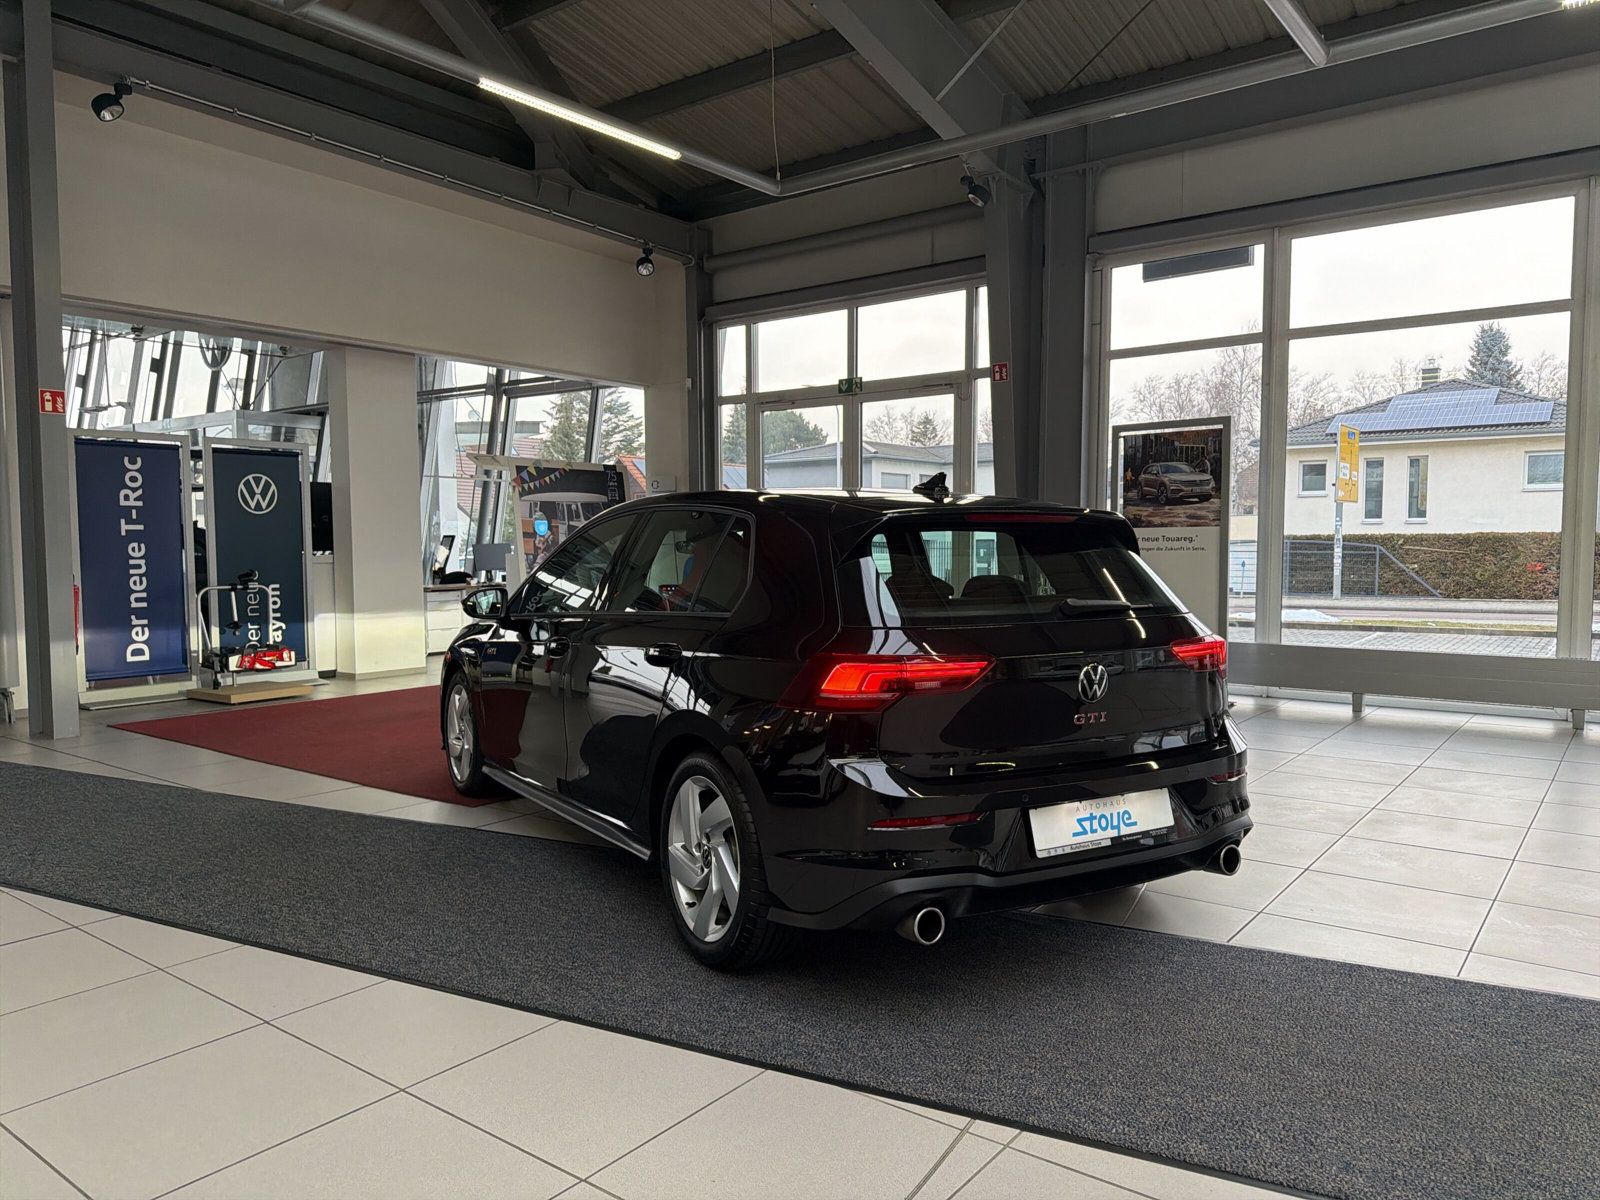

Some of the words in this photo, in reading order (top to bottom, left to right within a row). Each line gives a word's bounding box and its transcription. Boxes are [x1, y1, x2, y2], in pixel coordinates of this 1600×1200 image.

[119, 456, 145, 536] T-Roc
[1141, 534, 1160, 542] neue
[128, 542, 148, 608] neue
[269, 583, 287, 642] ayron
[126, 614, 150, 662] Der
[1073, 711, 1107, 725] GTI
[1075, 798, 1128, 813] AUTOHAUS
